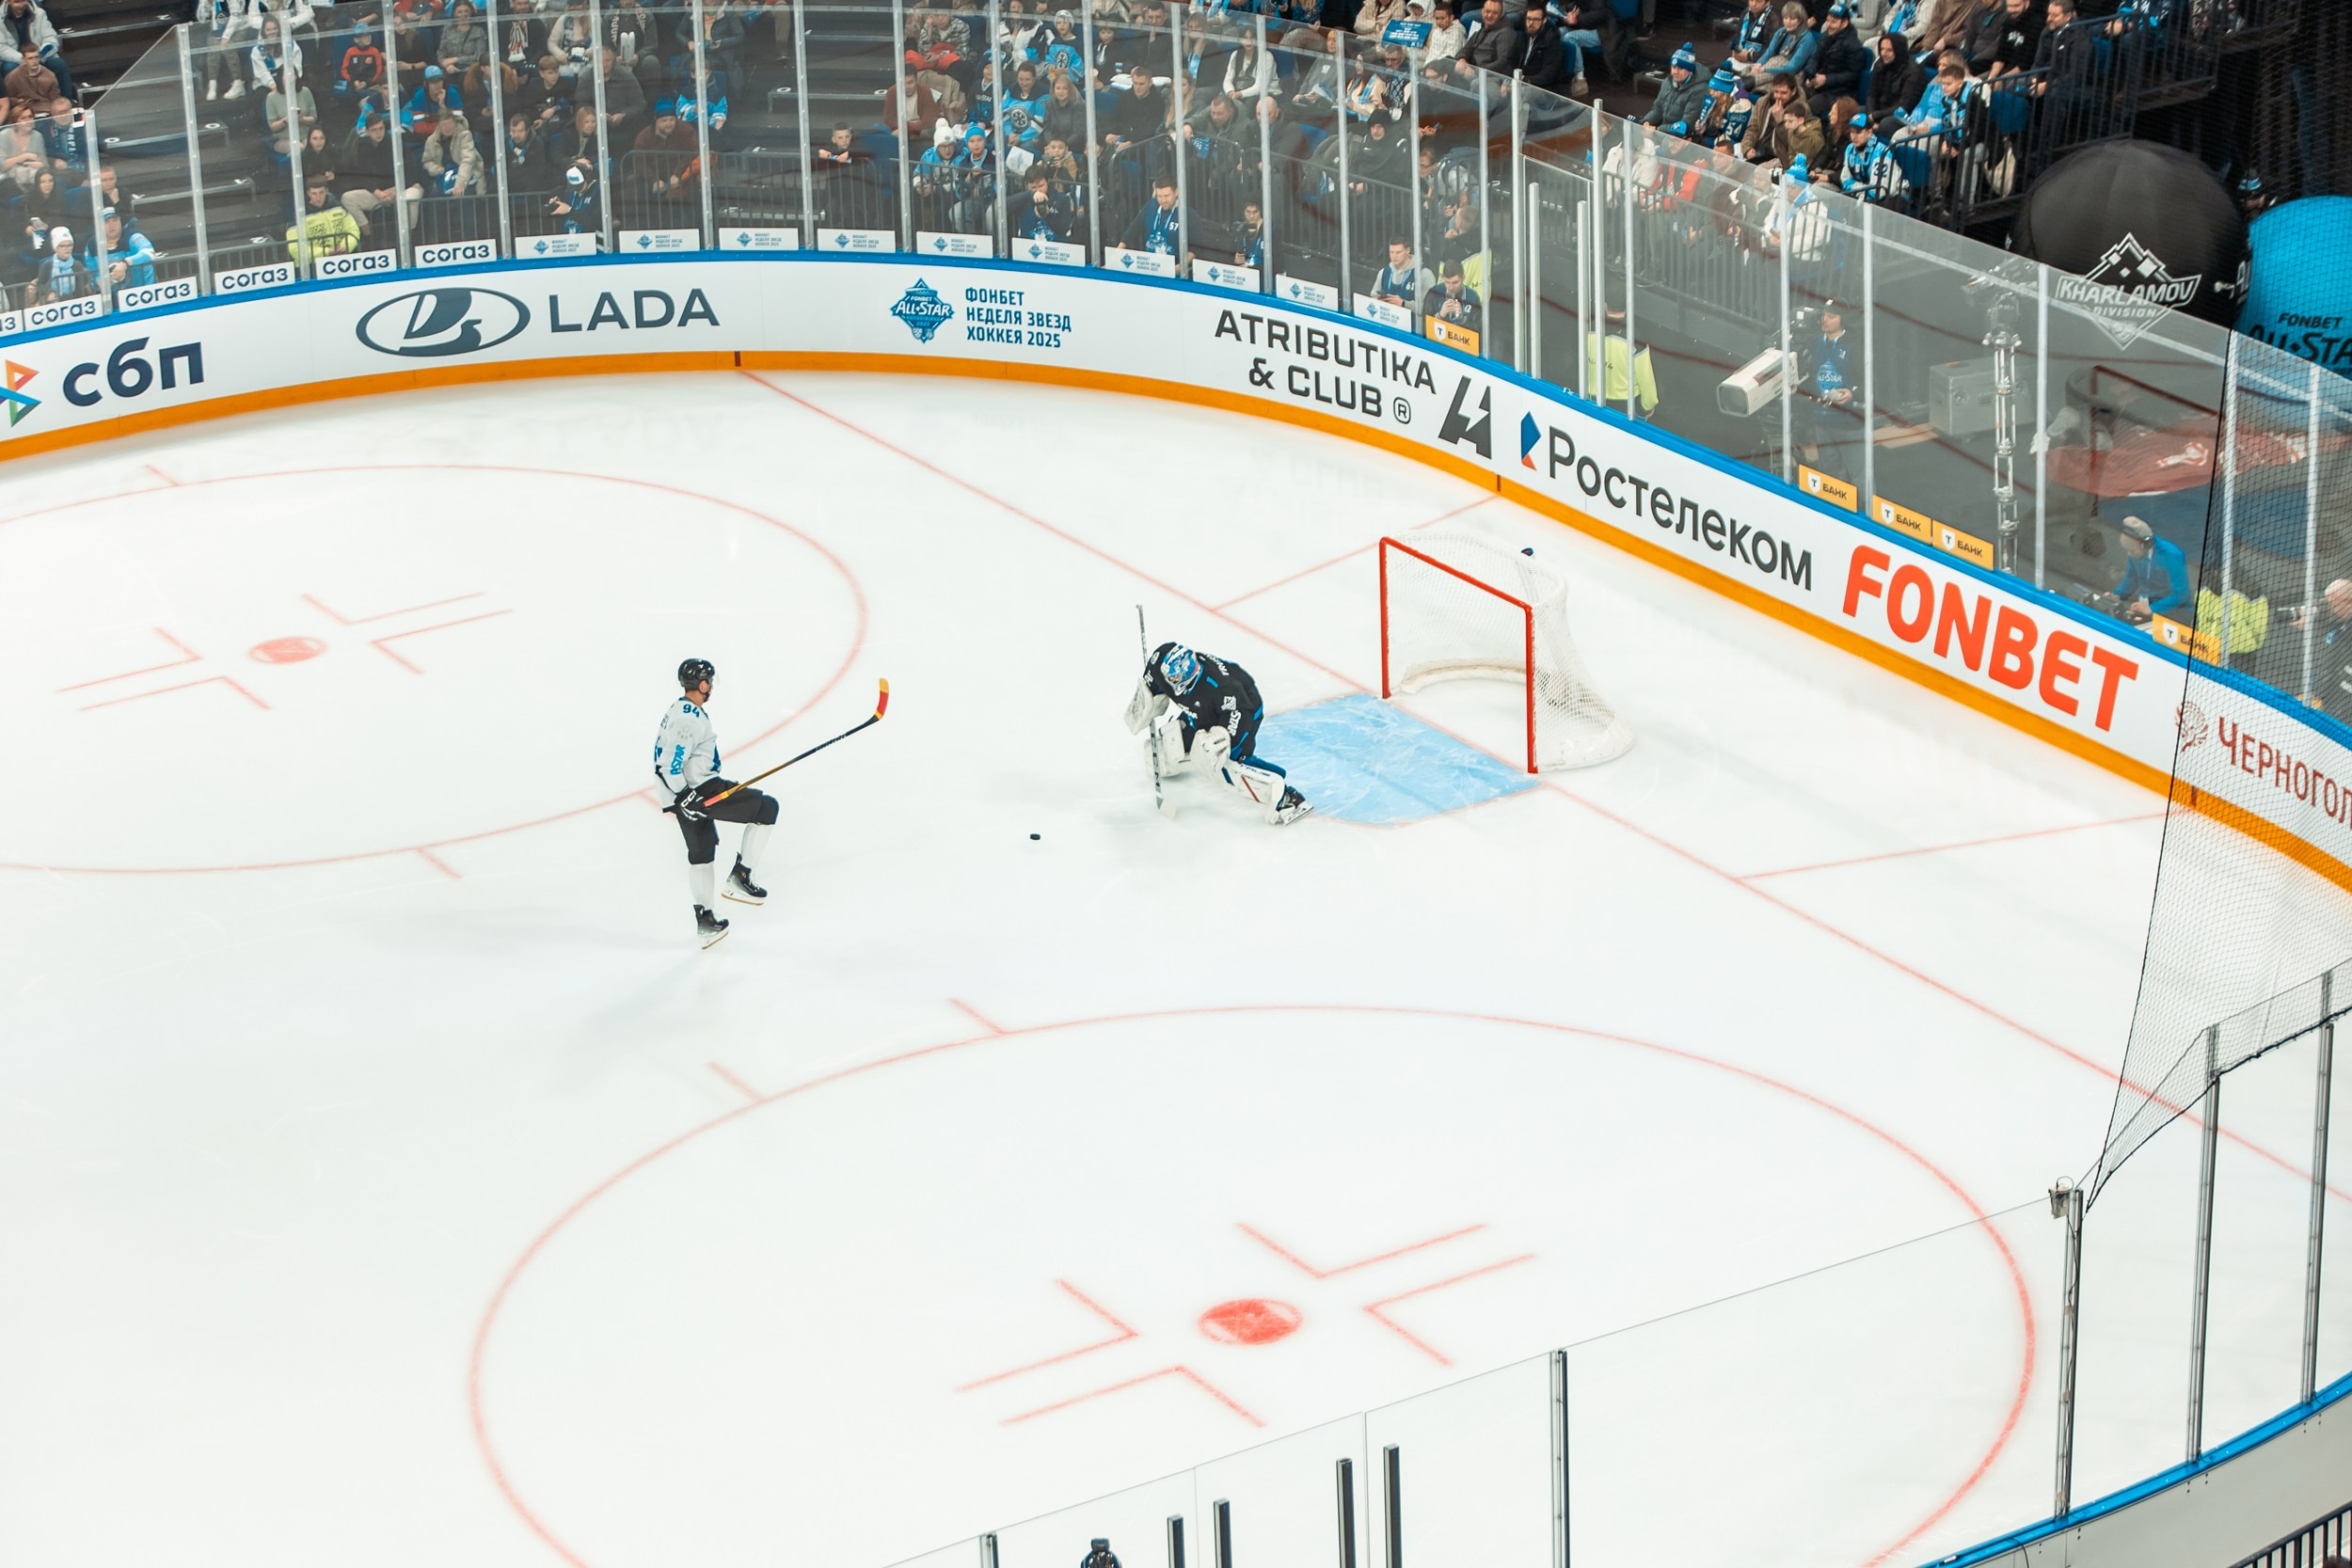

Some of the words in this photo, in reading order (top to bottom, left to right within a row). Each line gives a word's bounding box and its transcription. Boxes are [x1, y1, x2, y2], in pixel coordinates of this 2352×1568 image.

[1168, 221, 1180, 231] 57
[965, 286, 1025, 307] ФОНБЕТ
[2059, 278, 2197, 306] KHARLAMOV
[548, 288, 721, 333] LADA
[967, 307, 1023, 325] НЕДЕЛЯ
[1027, 311, 1073, 333] ЗВЕЗД
[2093, 306, 2158, 318] DIVISION
[2279, 312, 2343, 329] FONBET
[967, 325, 1023, 344] ХОККЕЯ
[1027, 331, 1061, 348] 2025
[1447, 330, 1471, 346] БАНК
[1216, 309, 1438, 394] ATRIBUTIKA
[62, 337, 205, 406] сбп
[1248, 357, 1276, 390] &
[1288, 365, 1383, 418] CLUB
[1822, 482, 1848, 500] БАНК
[1549, 426, 1813, 592] Ростелеком
[1896, 512, 1921, 531] БАНК
[1957, 538, 1983, 557] БАНК
[1842, 545, 2139, 732] FONBET
[2180, 634, 2210, 654] БАНК
[683, 704, 700, 719] 94
